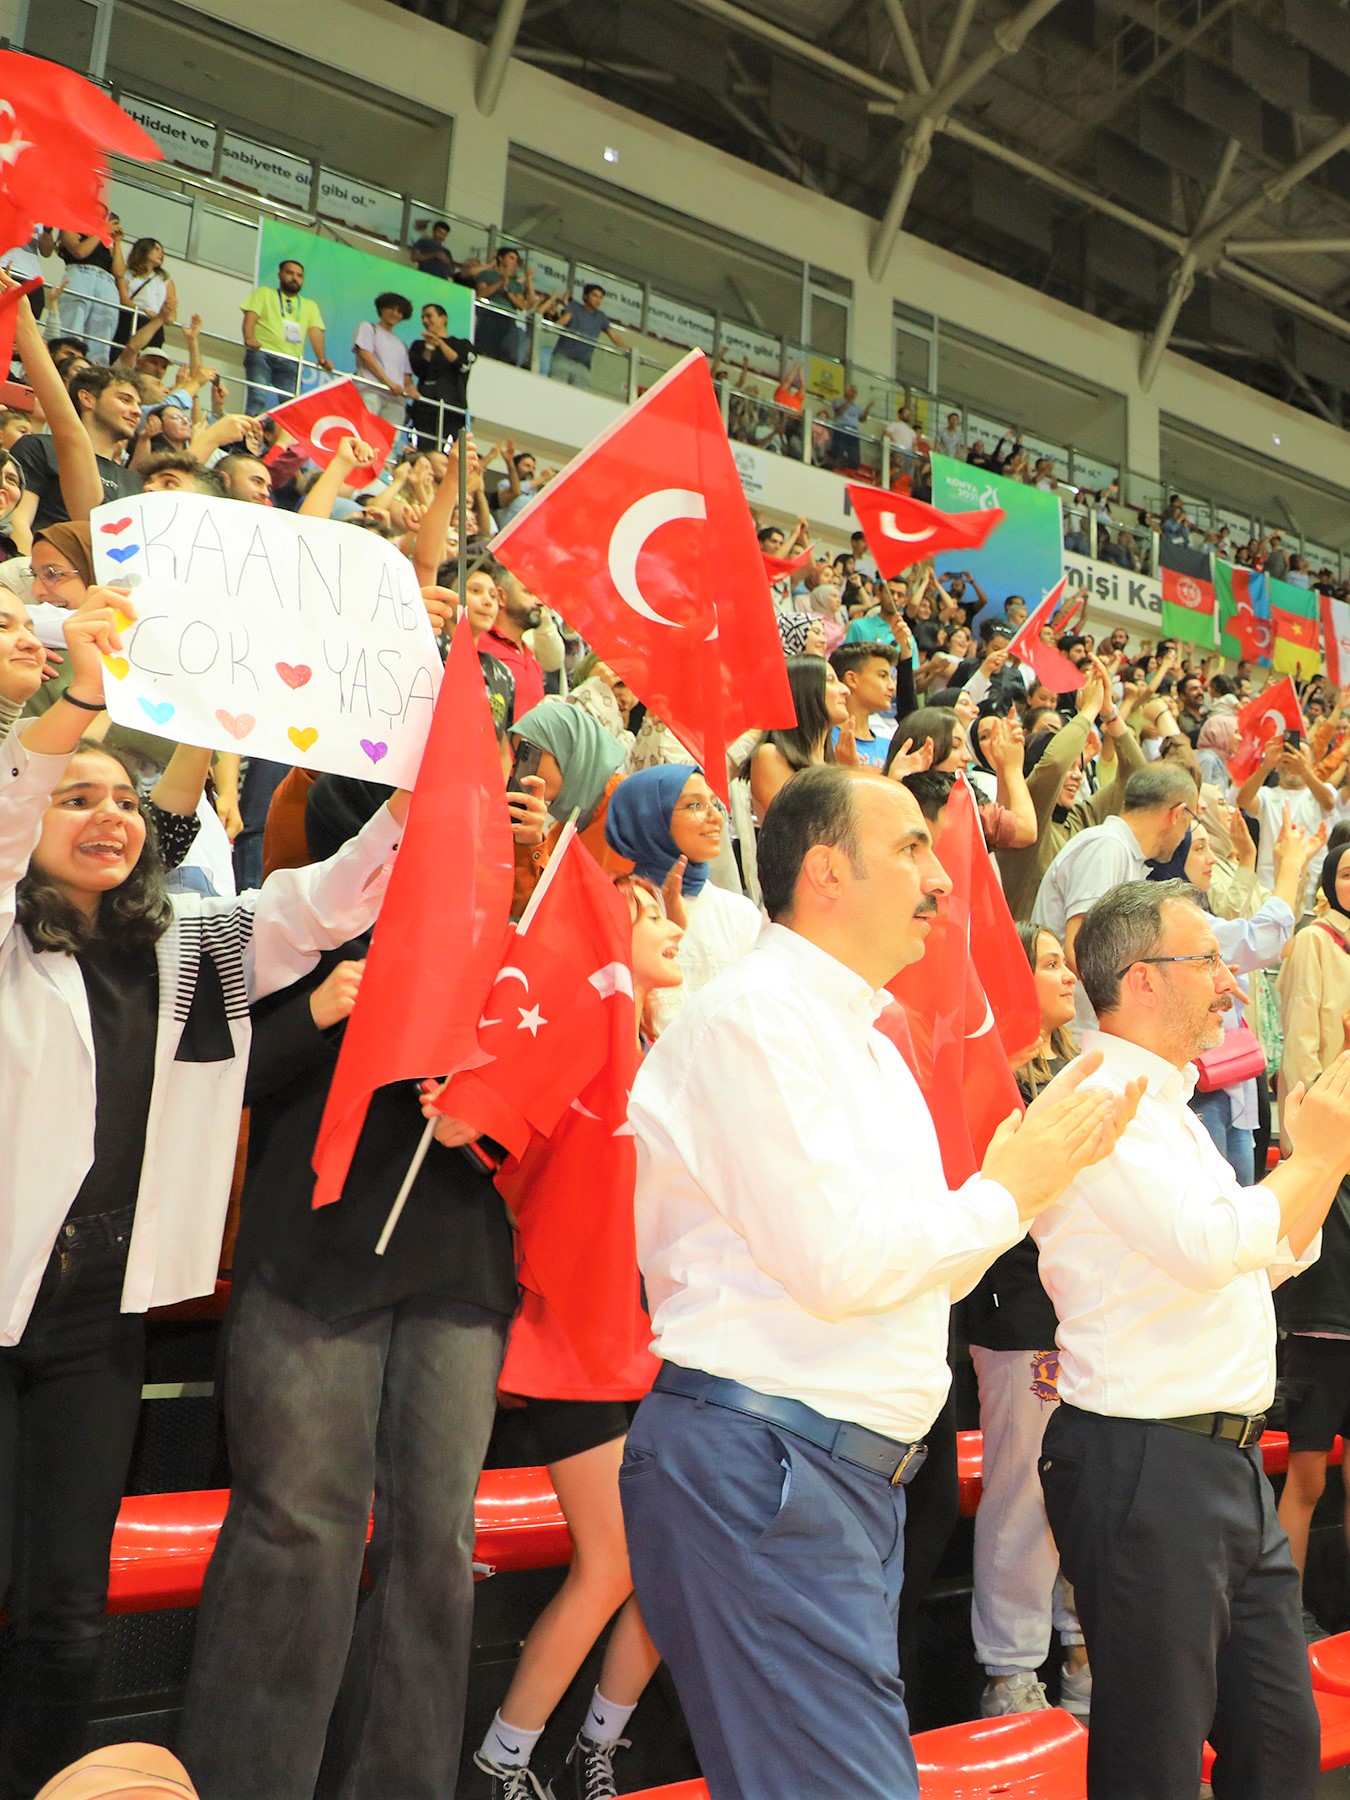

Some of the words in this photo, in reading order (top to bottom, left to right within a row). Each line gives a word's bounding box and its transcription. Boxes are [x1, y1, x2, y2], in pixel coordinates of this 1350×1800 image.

[190, 135, 210, 149] ve
[213, 146, 292, 179] sabiyette
[295, 171, 314, 188] öl
[321, 183, 348, 200] gibi
[140, 502, 342, 616] KAAN
[323, 638, 435, 730] YAŞA
